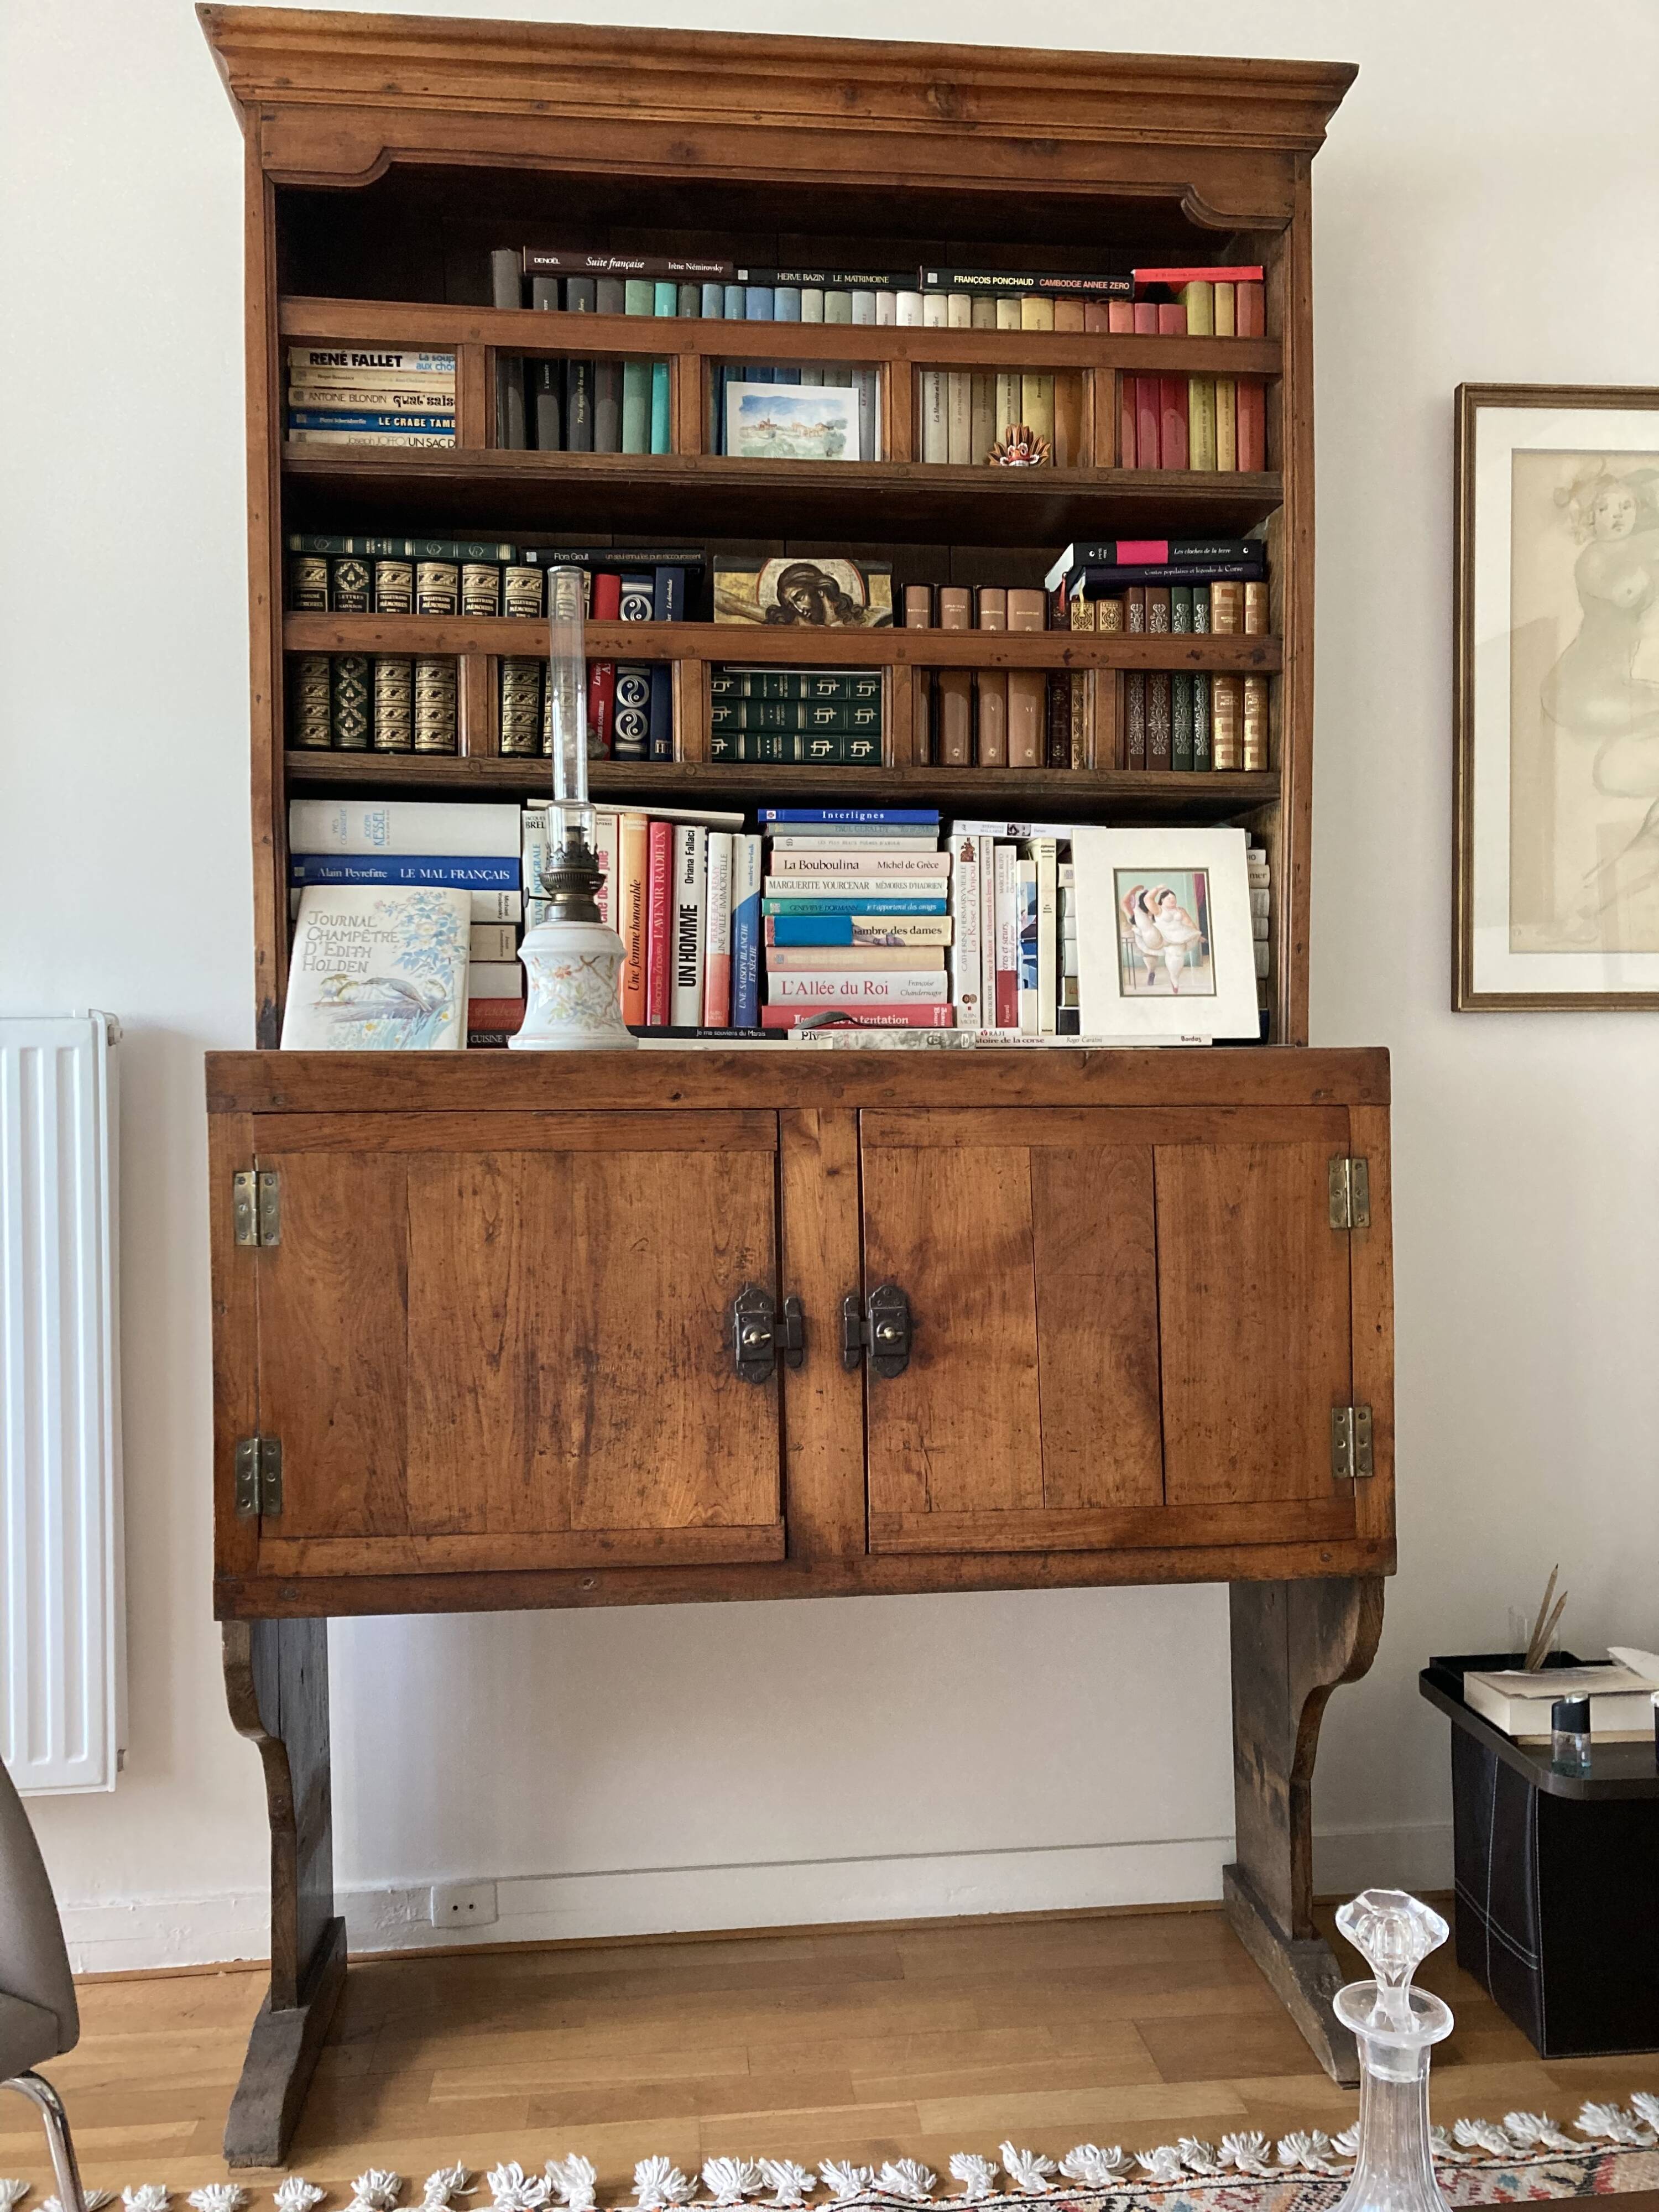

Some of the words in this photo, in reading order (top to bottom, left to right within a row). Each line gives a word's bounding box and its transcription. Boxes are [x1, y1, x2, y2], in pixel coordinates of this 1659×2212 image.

[586, 257, 607, 267] Suite
[607, 258, 644, 270] française
[668, 262, 684, 270] Irène
[686, 263, 723, 272] Némirovsky
[844, 275, 889, 284] MATRIMOINE
[954, 275, 991, 285] FRANÇOIS
[993, 276, 1034, 286] PONCHAUD
[1040, 279, 1082, 288] CAMBODGE
[1083, 280, 1108, 289] ANNEE
[1109, 281, 1130, 290] ZERO
[310, 351, 348, 366] RENÉ
[352, 354, 403, 367] FALLET
[431, 354, 455, 363] soup
[309, 392, 346, 402] ANTOINE
[349, 393, 387, 403] BLONDIN
[427, 395, 455, 406] sais
[394, 418, 426, 427] CRABE
[409, 437, 425, 447] UN
[426, 438, 446, 448] SAC
[822, 811, 885, 821] Interlignes
[373, 809, 385, 846] KESSEL
[685, 830, 695, 855] Fallaci
[655, 831, 665, 883] RADIEUX
[784, 860, 796, 870] La
[799, 859, 859, 870] Bouboulina
[877, 860, 904, 869] Michel
[905, 860, 914, 869] de
[916, 860, 940, 869] Grèce
[318, 867, 342, 877] Alain
[345, 867, 387, 880] Peyrefitte
[400, 869, 415, 879] LE
[420, 869, 447, 879] MAL
[451, 870, 510, 881] FRANÇAIS
[685, 858, 695, 884] Oriana
[720, 853, 728, 909] IMMORTELLE
[769, 881, 820, 890] MARGUERITE
[822, 881, 869, 890] YOURCENAR
[875, 880, 907, 890] MÉMOIRES
[909, 881, 942, 890] D'HADRIEN
[629, 879, 641, 932] honorable
[653, 887, 664, 938] L'AVENIR
[307, 910, 378, 928] JOURNAL
[968, 910, 977, 936] Rose
[679, 904, 698, 962] HOMME
[889, 925, 907, 935] des
[910, 925, 942, 935] dames
[304, 941, 372, 958] D'EDITH
[739, 924, 748, 961] BLANCHE
[967, 939, 977, 953] La
[629, 933, 642, 971] femme
[747, 945, 757, 974] SÈCHE
[302, 956, 370, 973] HOLDEN
[628, 971, 640, 992] Une
[678, 966, 696, 987] UN
[739, 962, 748, 989] SAISON
[653, 975, 662, 1014] Alexandre
[781, 980, 835, 995] L'Allée
[841, 981, 858, 994] du
[863, 981, 889, 995] Roi
[900, 989, 943, 998] Chandernagor
[860, 1014, 909, 1025] tentation
[470, 1035, 503, 1044] CUISINE
